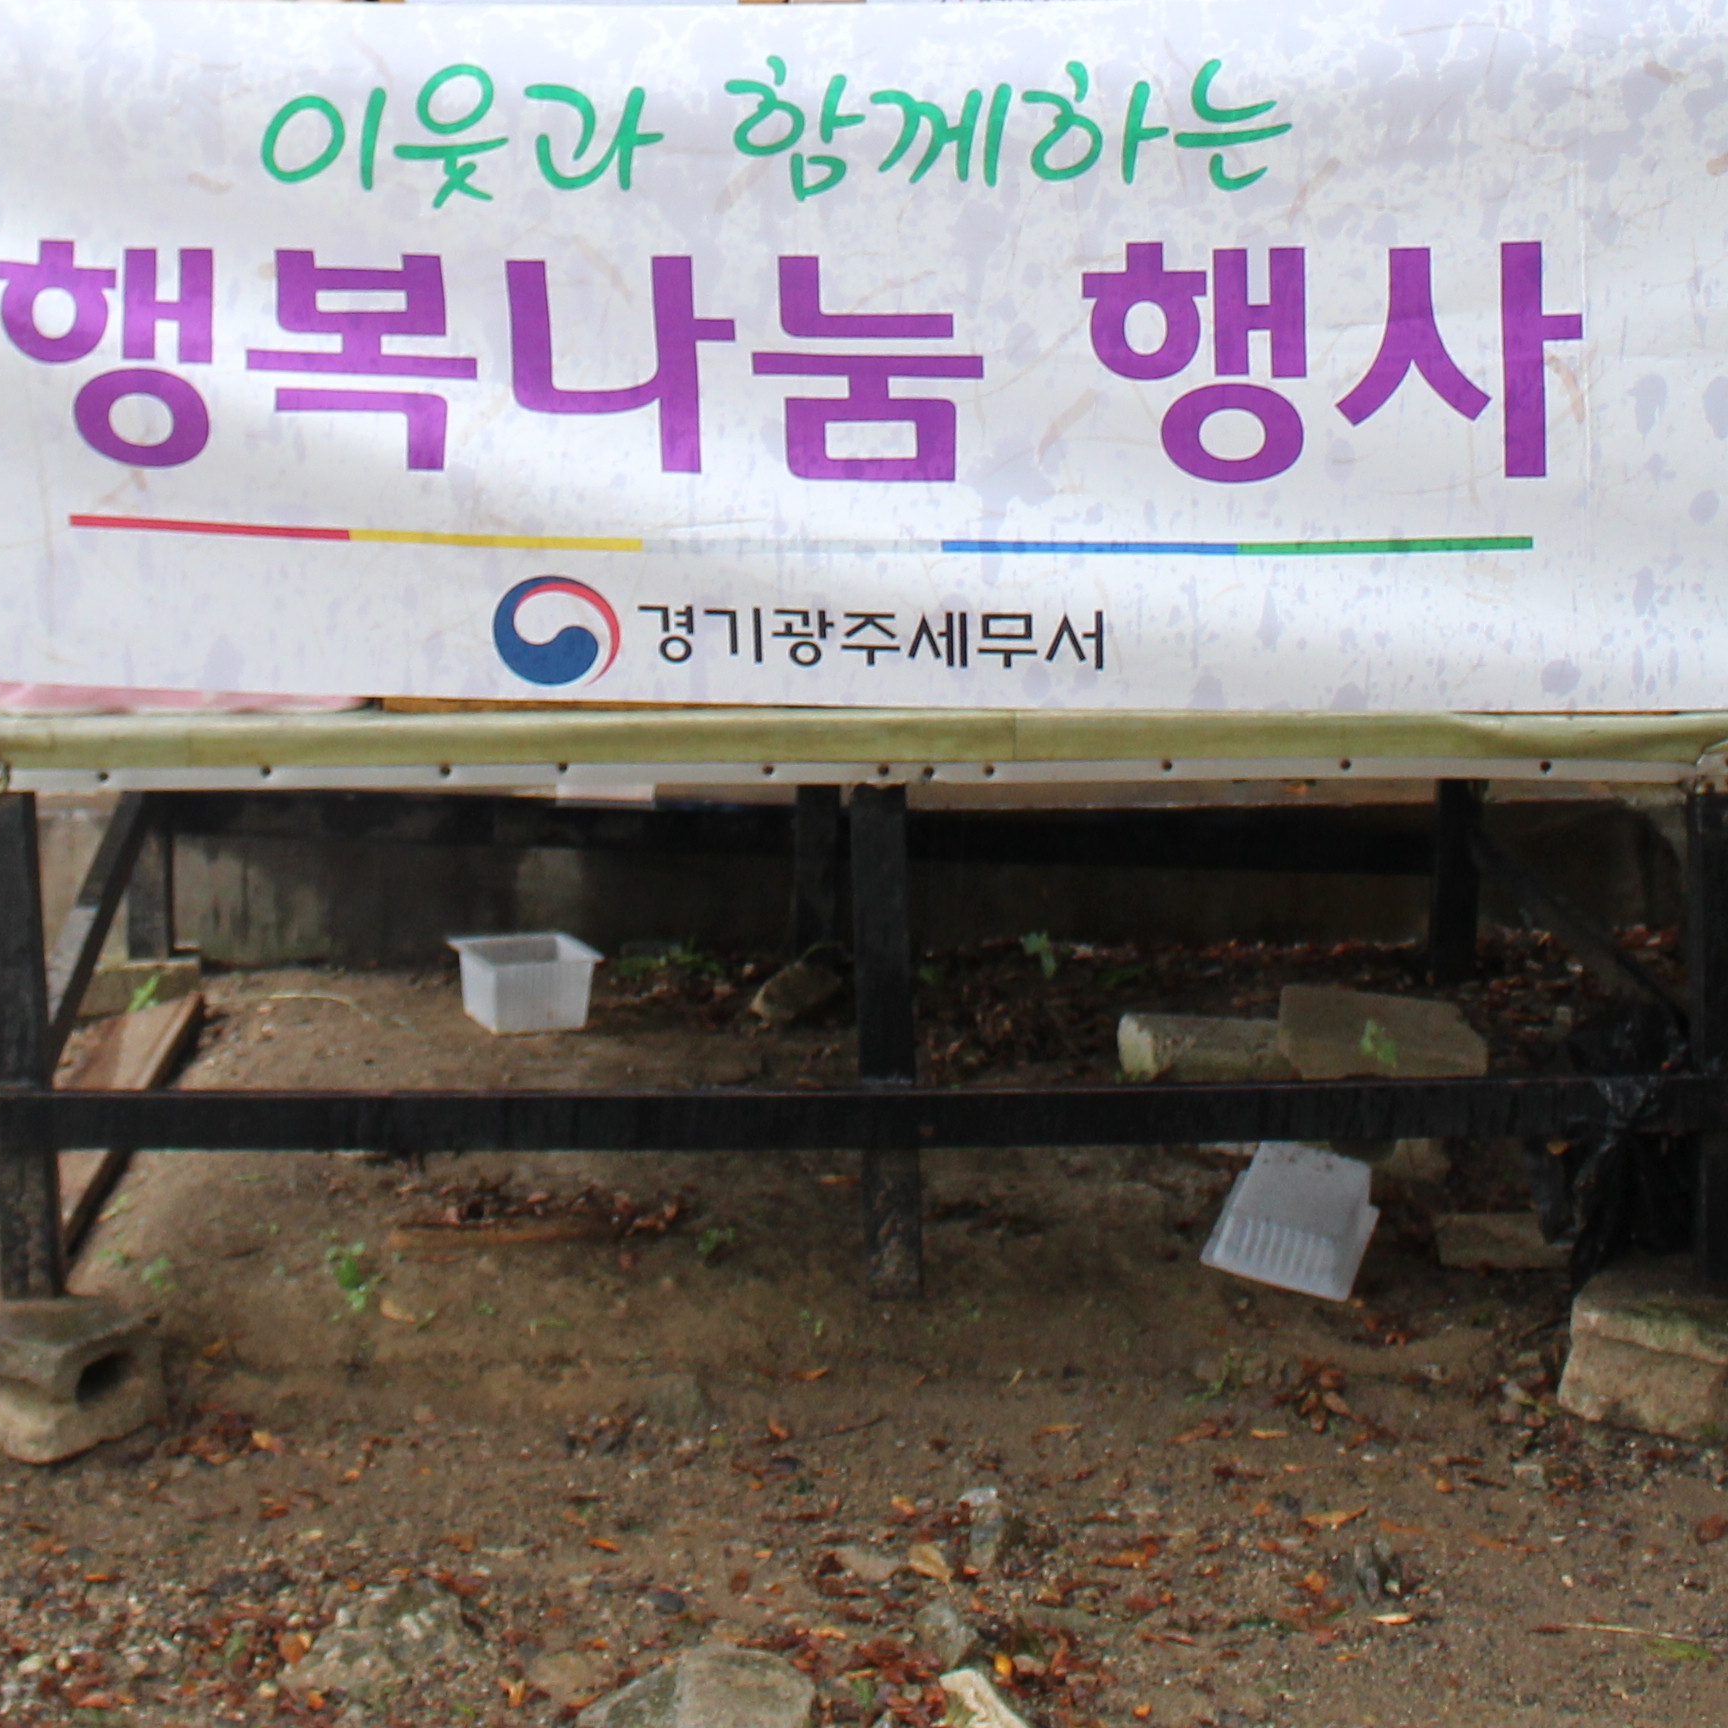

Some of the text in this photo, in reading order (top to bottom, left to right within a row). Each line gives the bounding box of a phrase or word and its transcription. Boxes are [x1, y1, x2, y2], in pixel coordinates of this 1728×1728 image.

[261, 56, 1294, 210] 이웃과 함께하는
[1082, 241, 1584, 485] 행사
[637, 604, 1108, 672] 경기광주세무서
